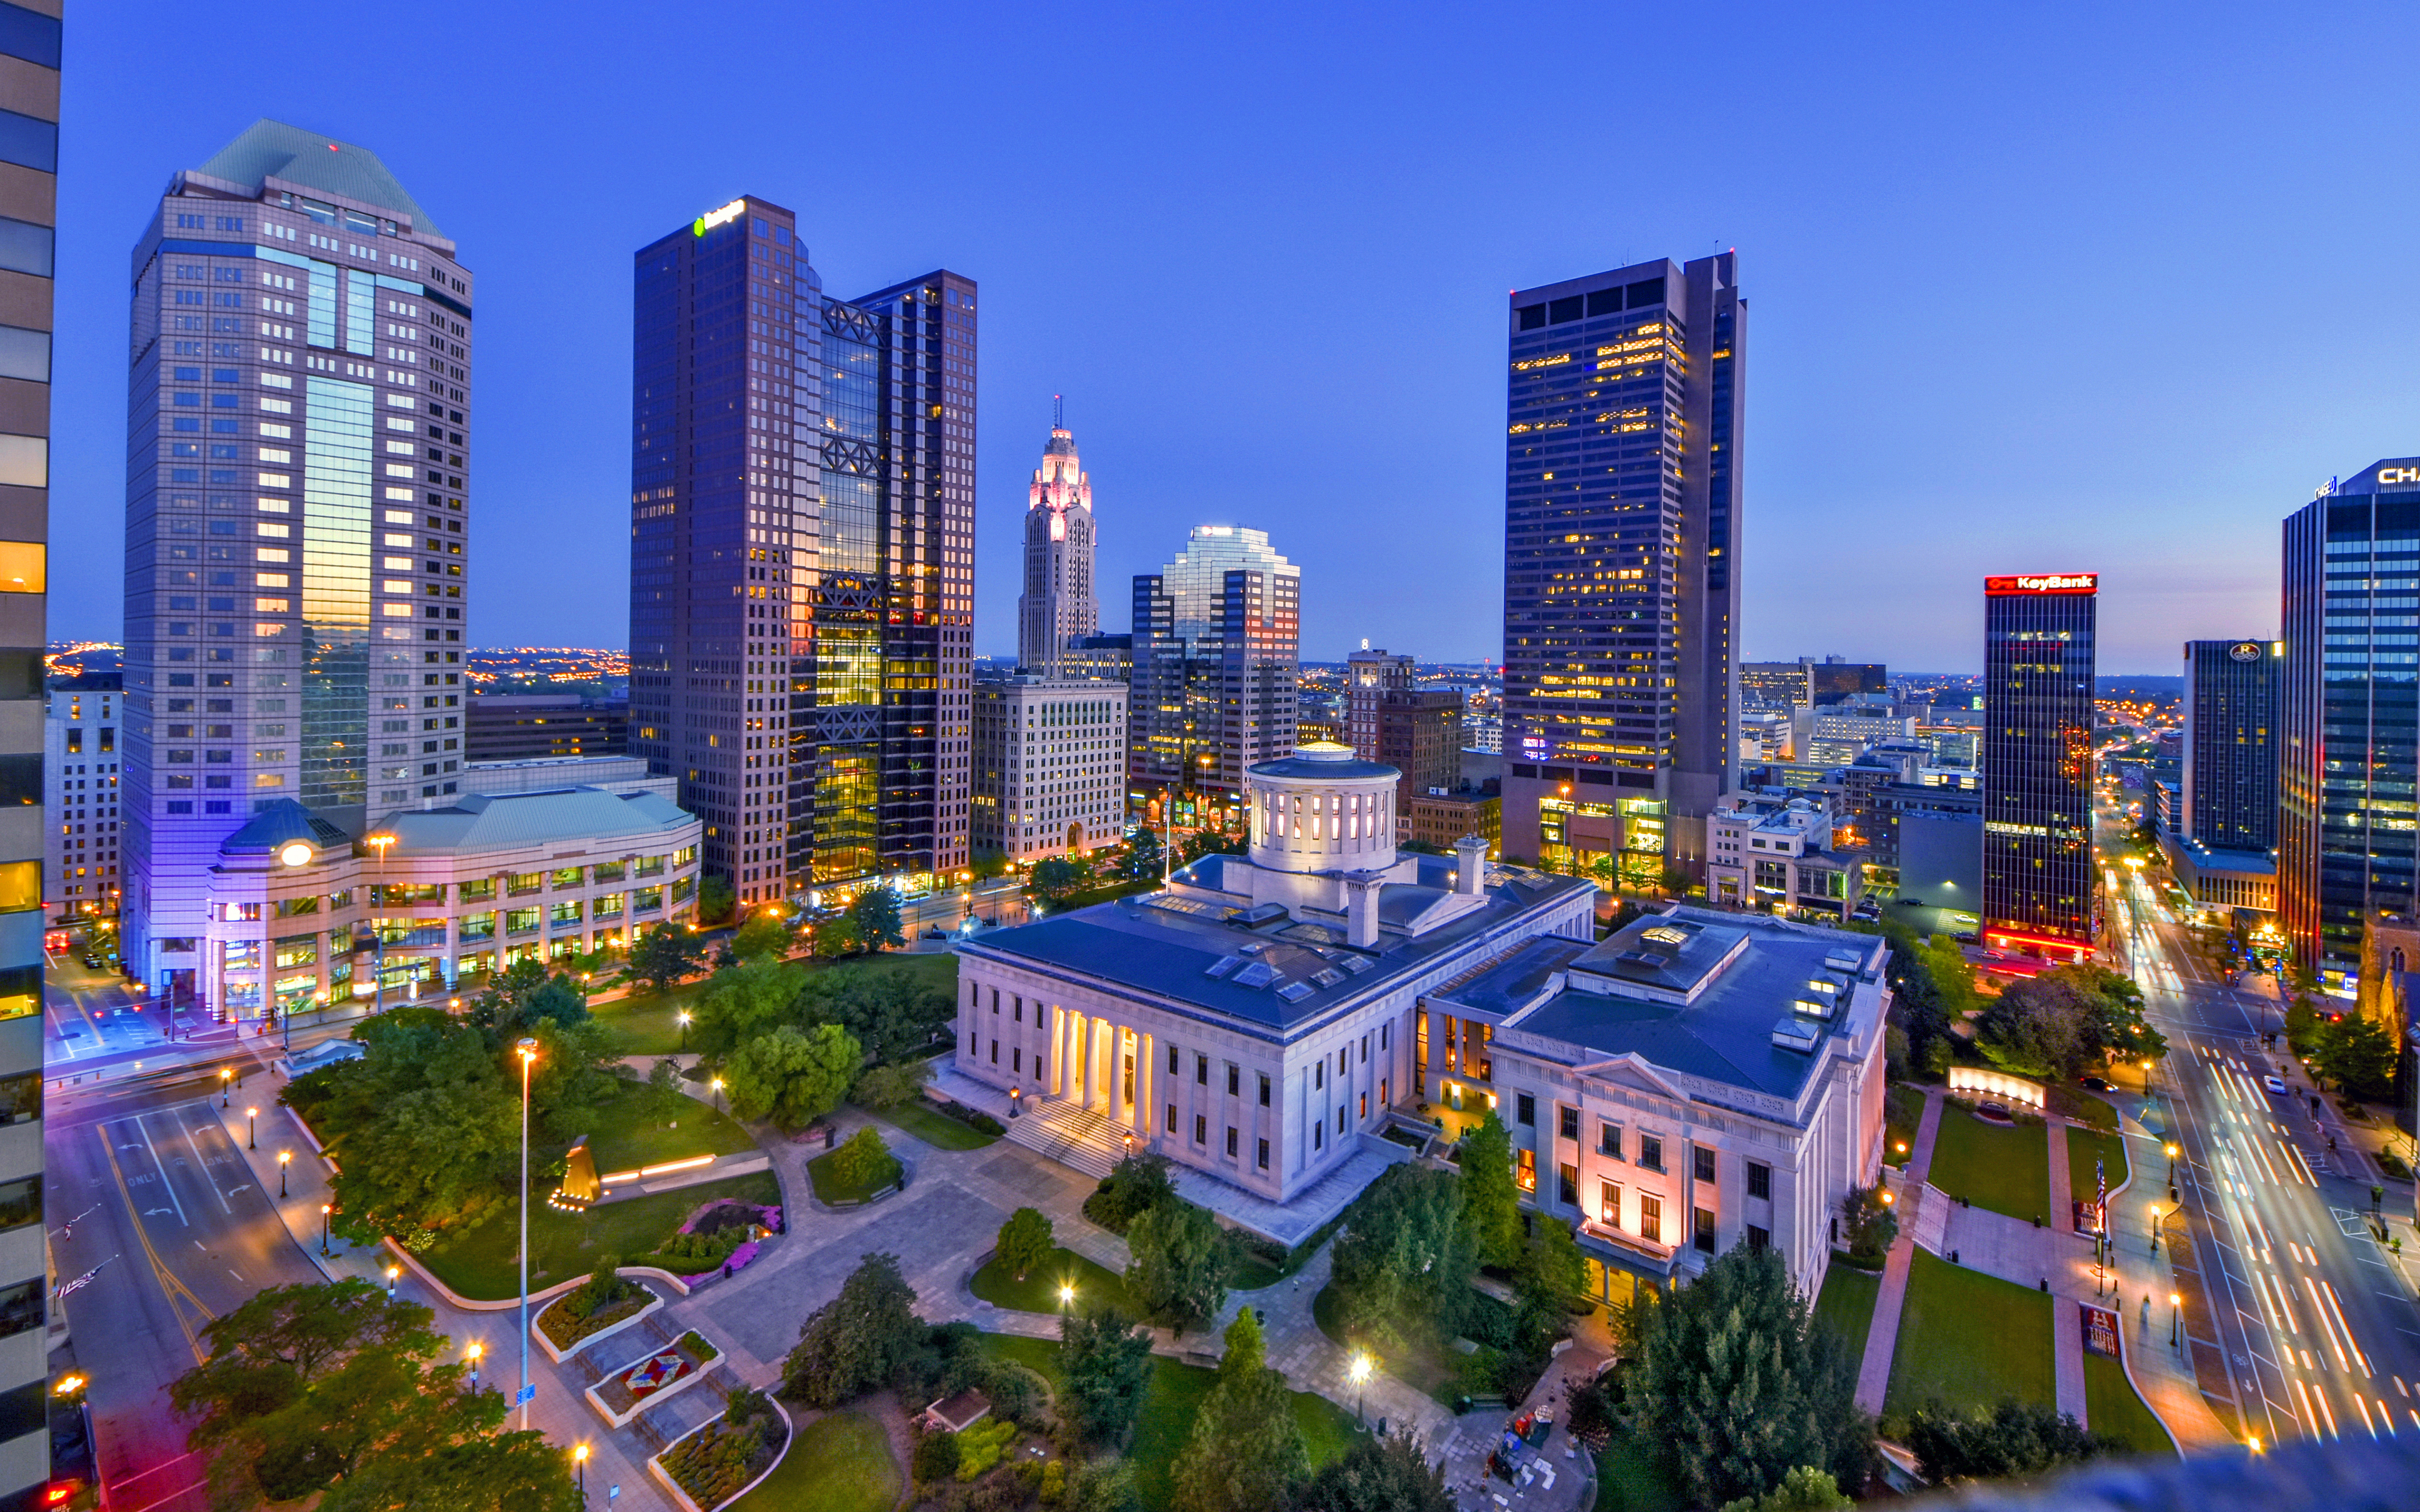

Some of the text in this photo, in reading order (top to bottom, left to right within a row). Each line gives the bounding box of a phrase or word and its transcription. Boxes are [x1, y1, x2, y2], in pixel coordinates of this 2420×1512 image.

[2378, 467, 2420, 484] CH
[2315, 480, 2330, 500] CHASE
[2018, 576, 2093, 591] KeyBank
[1362, 639, 1368, 650] 8
[207, 1153, 237, 1166] ONLY
[127, 1171, 157, 1187] ONLY
